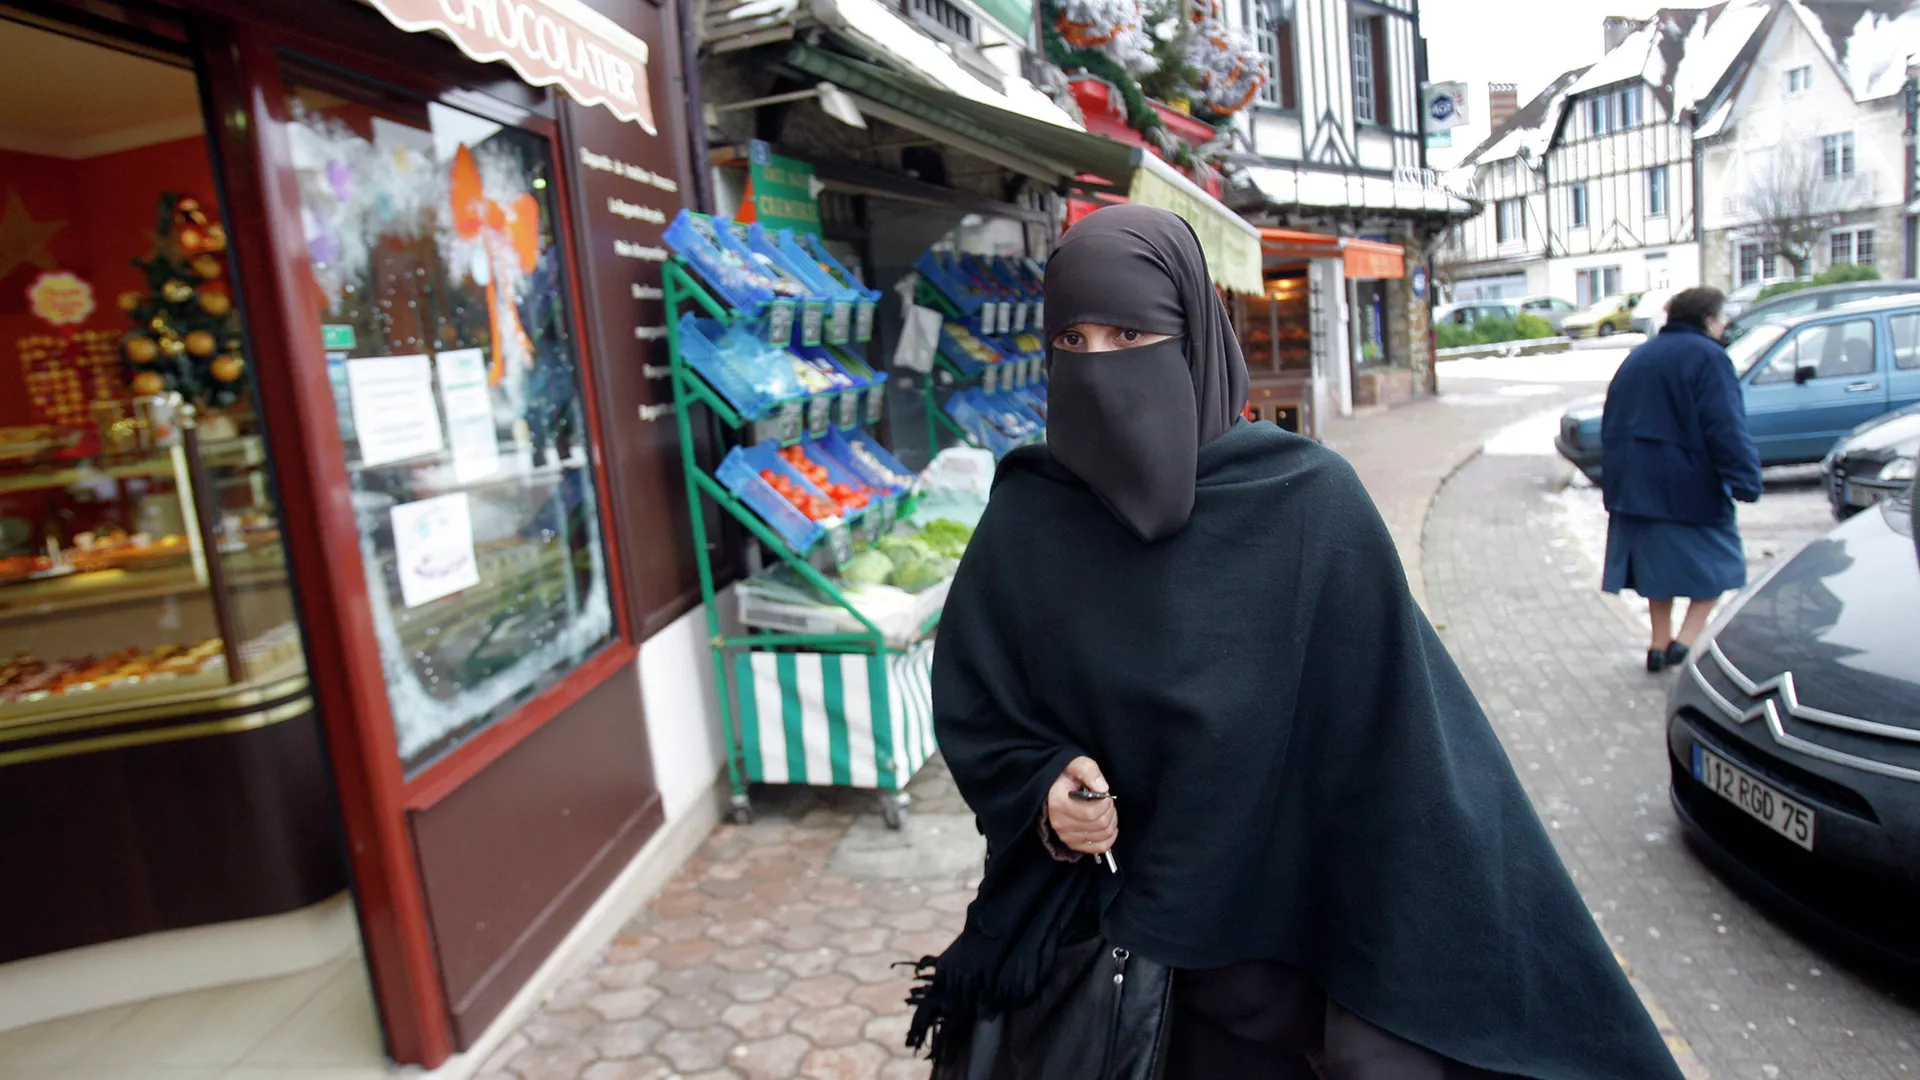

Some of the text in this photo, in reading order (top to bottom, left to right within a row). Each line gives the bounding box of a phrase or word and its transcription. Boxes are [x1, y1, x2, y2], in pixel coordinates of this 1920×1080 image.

[1705, 755, 1809, 842] 112 RGD 75
